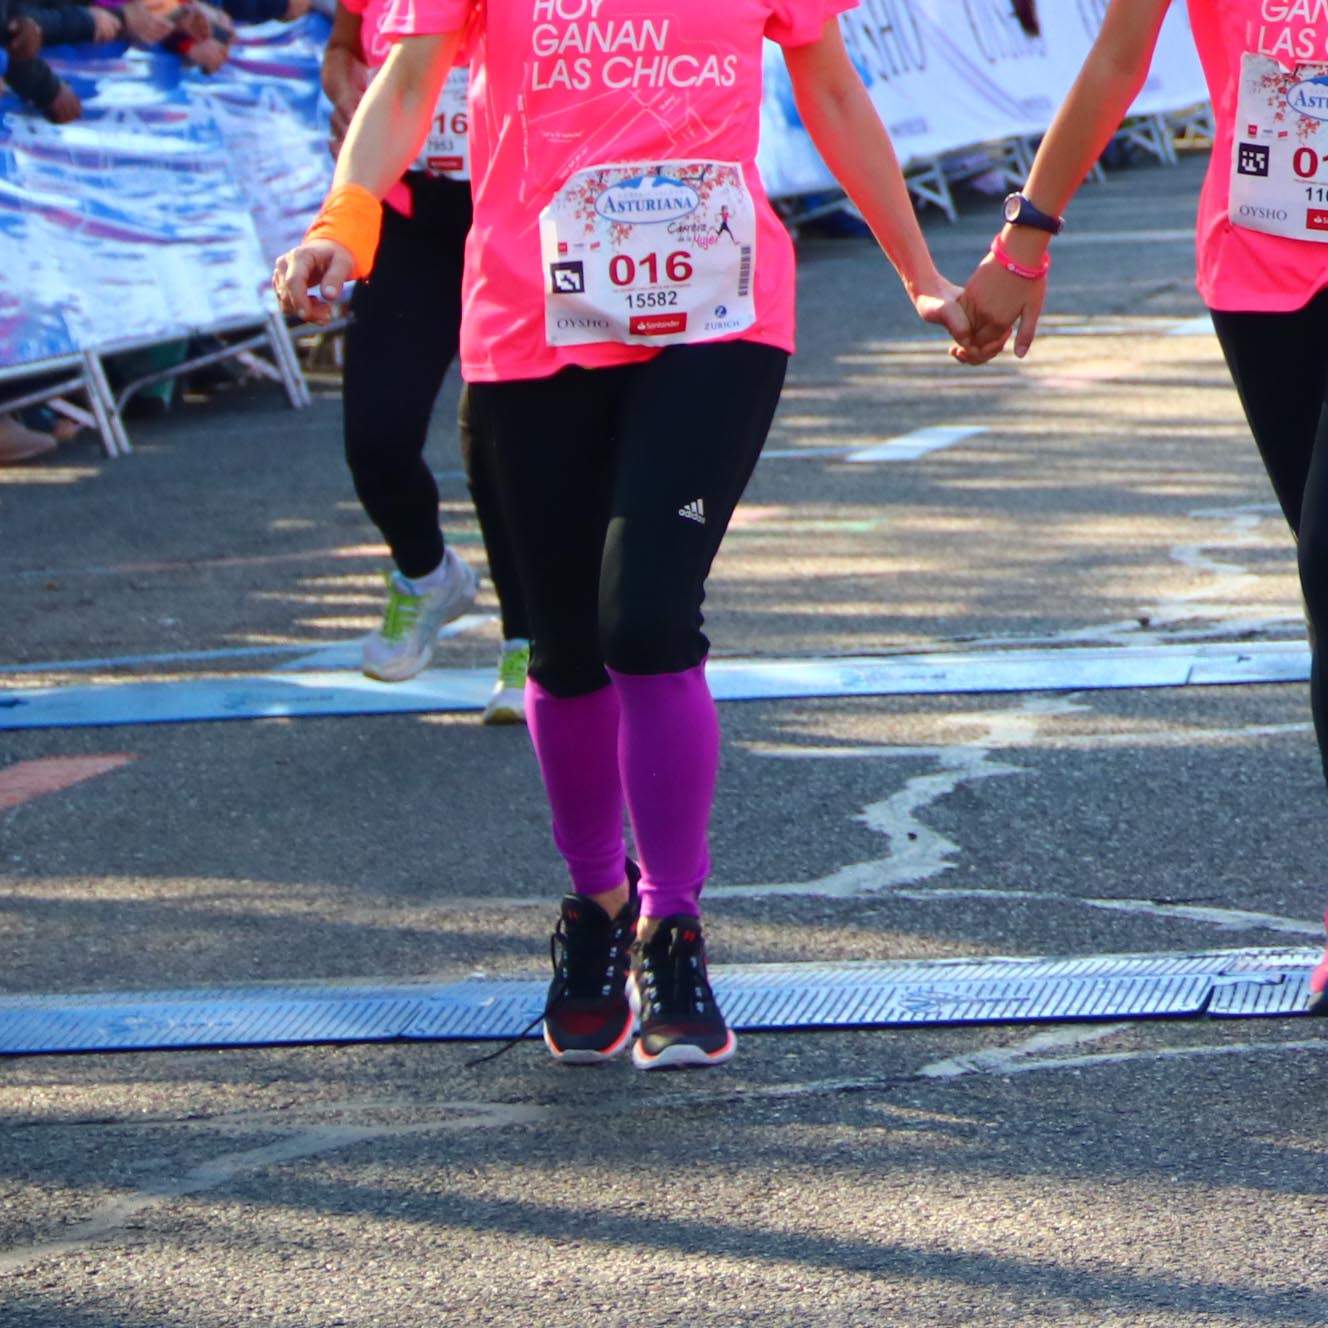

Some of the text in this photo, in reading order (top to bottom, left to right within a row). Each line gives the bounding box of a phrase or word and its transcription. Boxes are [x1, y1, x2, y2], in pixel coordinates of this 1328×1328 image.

[531, 20, 669, 56] GANAN
[1257, 25, 1316, 56] LAS
[531, 54, 737, 91] LAS CHICAS
[433, 112, 468, 135] 16
[603, 196, 694, 214] ASTURIANA
[1239, 205, 1288, 221] OYSHO
[609, 251, 694, 286] 016
[626, 291, 678, 309] 15582
